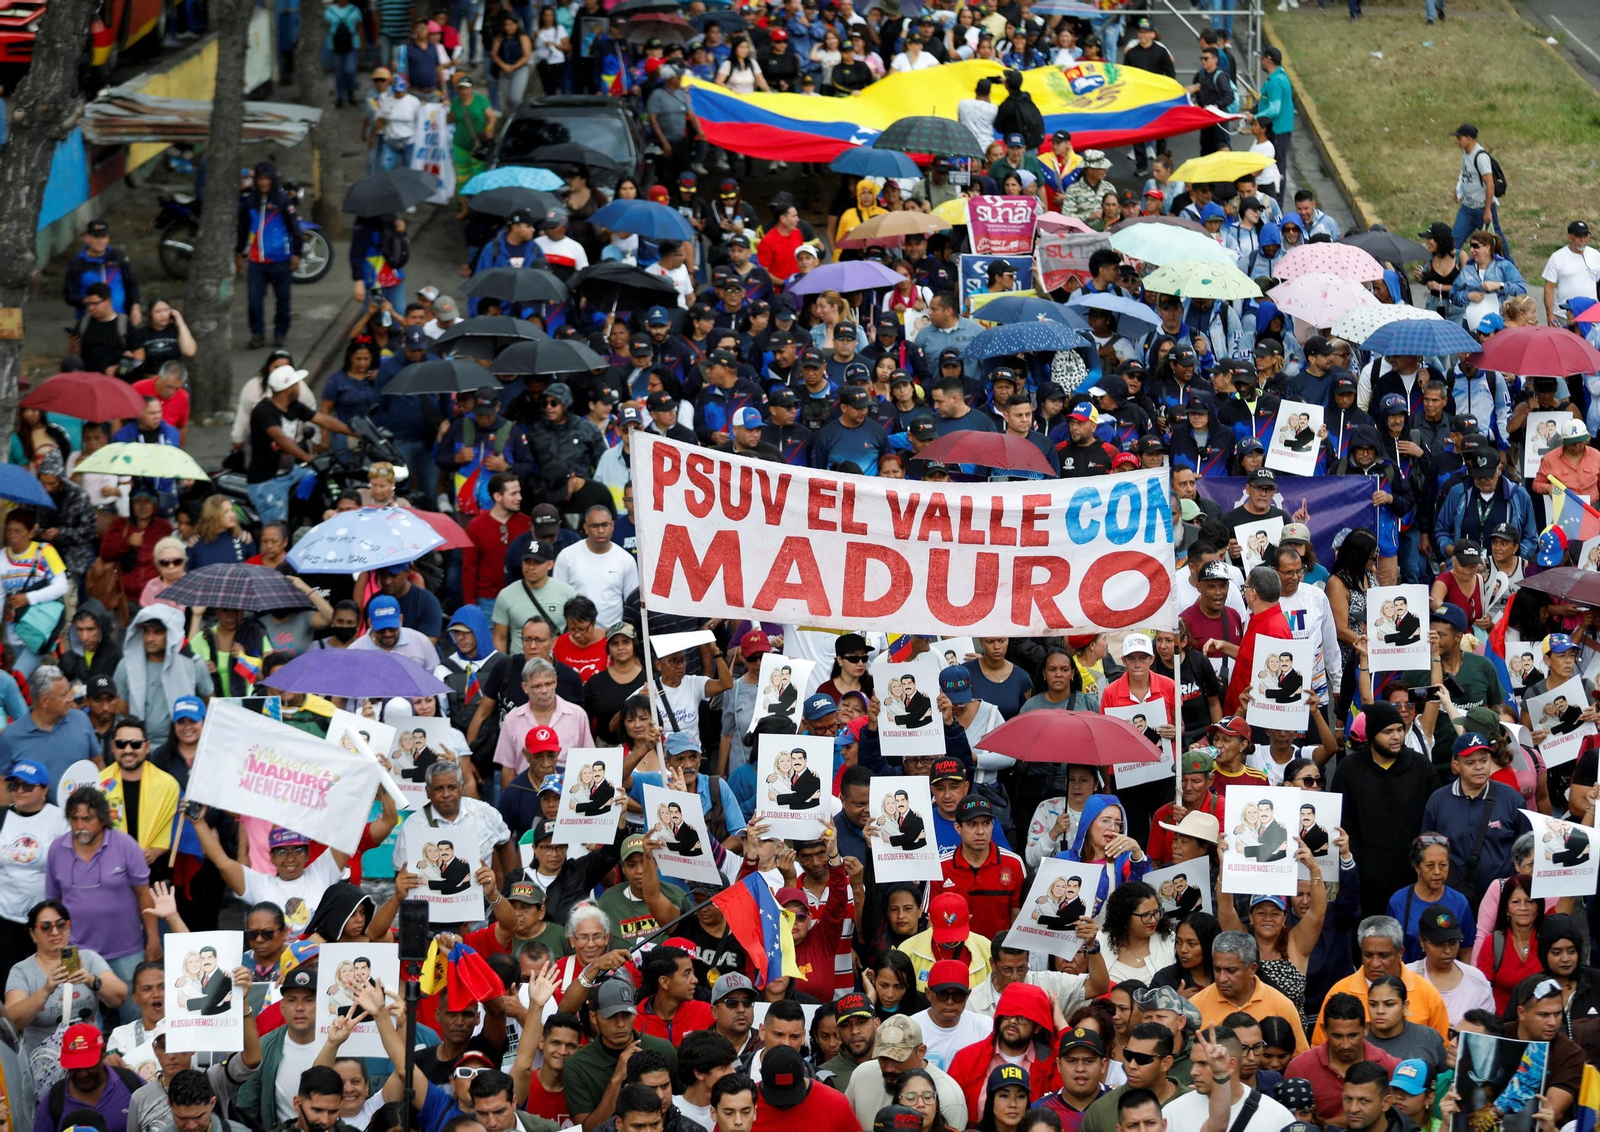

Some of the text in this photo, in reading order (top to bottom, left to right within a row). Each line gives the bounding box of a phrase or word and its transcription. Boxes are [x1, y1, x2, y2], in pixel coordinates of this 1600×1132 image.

[976, 205, 1032, 224] sunai
[652, 440, 1174, 548] PSUV EL VALLE CON
[651, 522, 1171, 629] MADURO
[1371, 646, 1427, 655] #LOSQUEREMOSDEVUELTA
[1252, 701, 1306, 713] #LOSQUEREMOSDEVUELTA
[882, 729, 941, 739] #LOSQUEREMOSDEVUELTA
[1543, 728, 1593, 750] #LOSQUEREMOSDEVUELTA
[248, 757, 331, 792] MADURO
[246, 775, 328, 810] VENEZUELA
[963, 801, 991, 810] CARACAS
[761, 810, 827, 821] #LOSQUEREMOSDEVUELTA
[560, 818, 614, 826] #LOSQUEREMOSDEVUELTA
[877, 852, 936, 861] #LOSQUEREMOSDEVUELTA
[1228, 863, 1293, 874] #LOSQUEREMOSDEVUELTA
[1537, 868, 1594, 878] #LOSQUEREMOSDEVUELTA
[414, 893, 480, 904] #LOSQUEREMOSDEVUELTA
[1017, 925, 1080, 944] #LOSQUEREMOSDEVUELTA
[171, 1018, 239, 1028] #LOSQUEREMOSDEVUELTA
[1001, 1067, 1022, 1080] VEN
